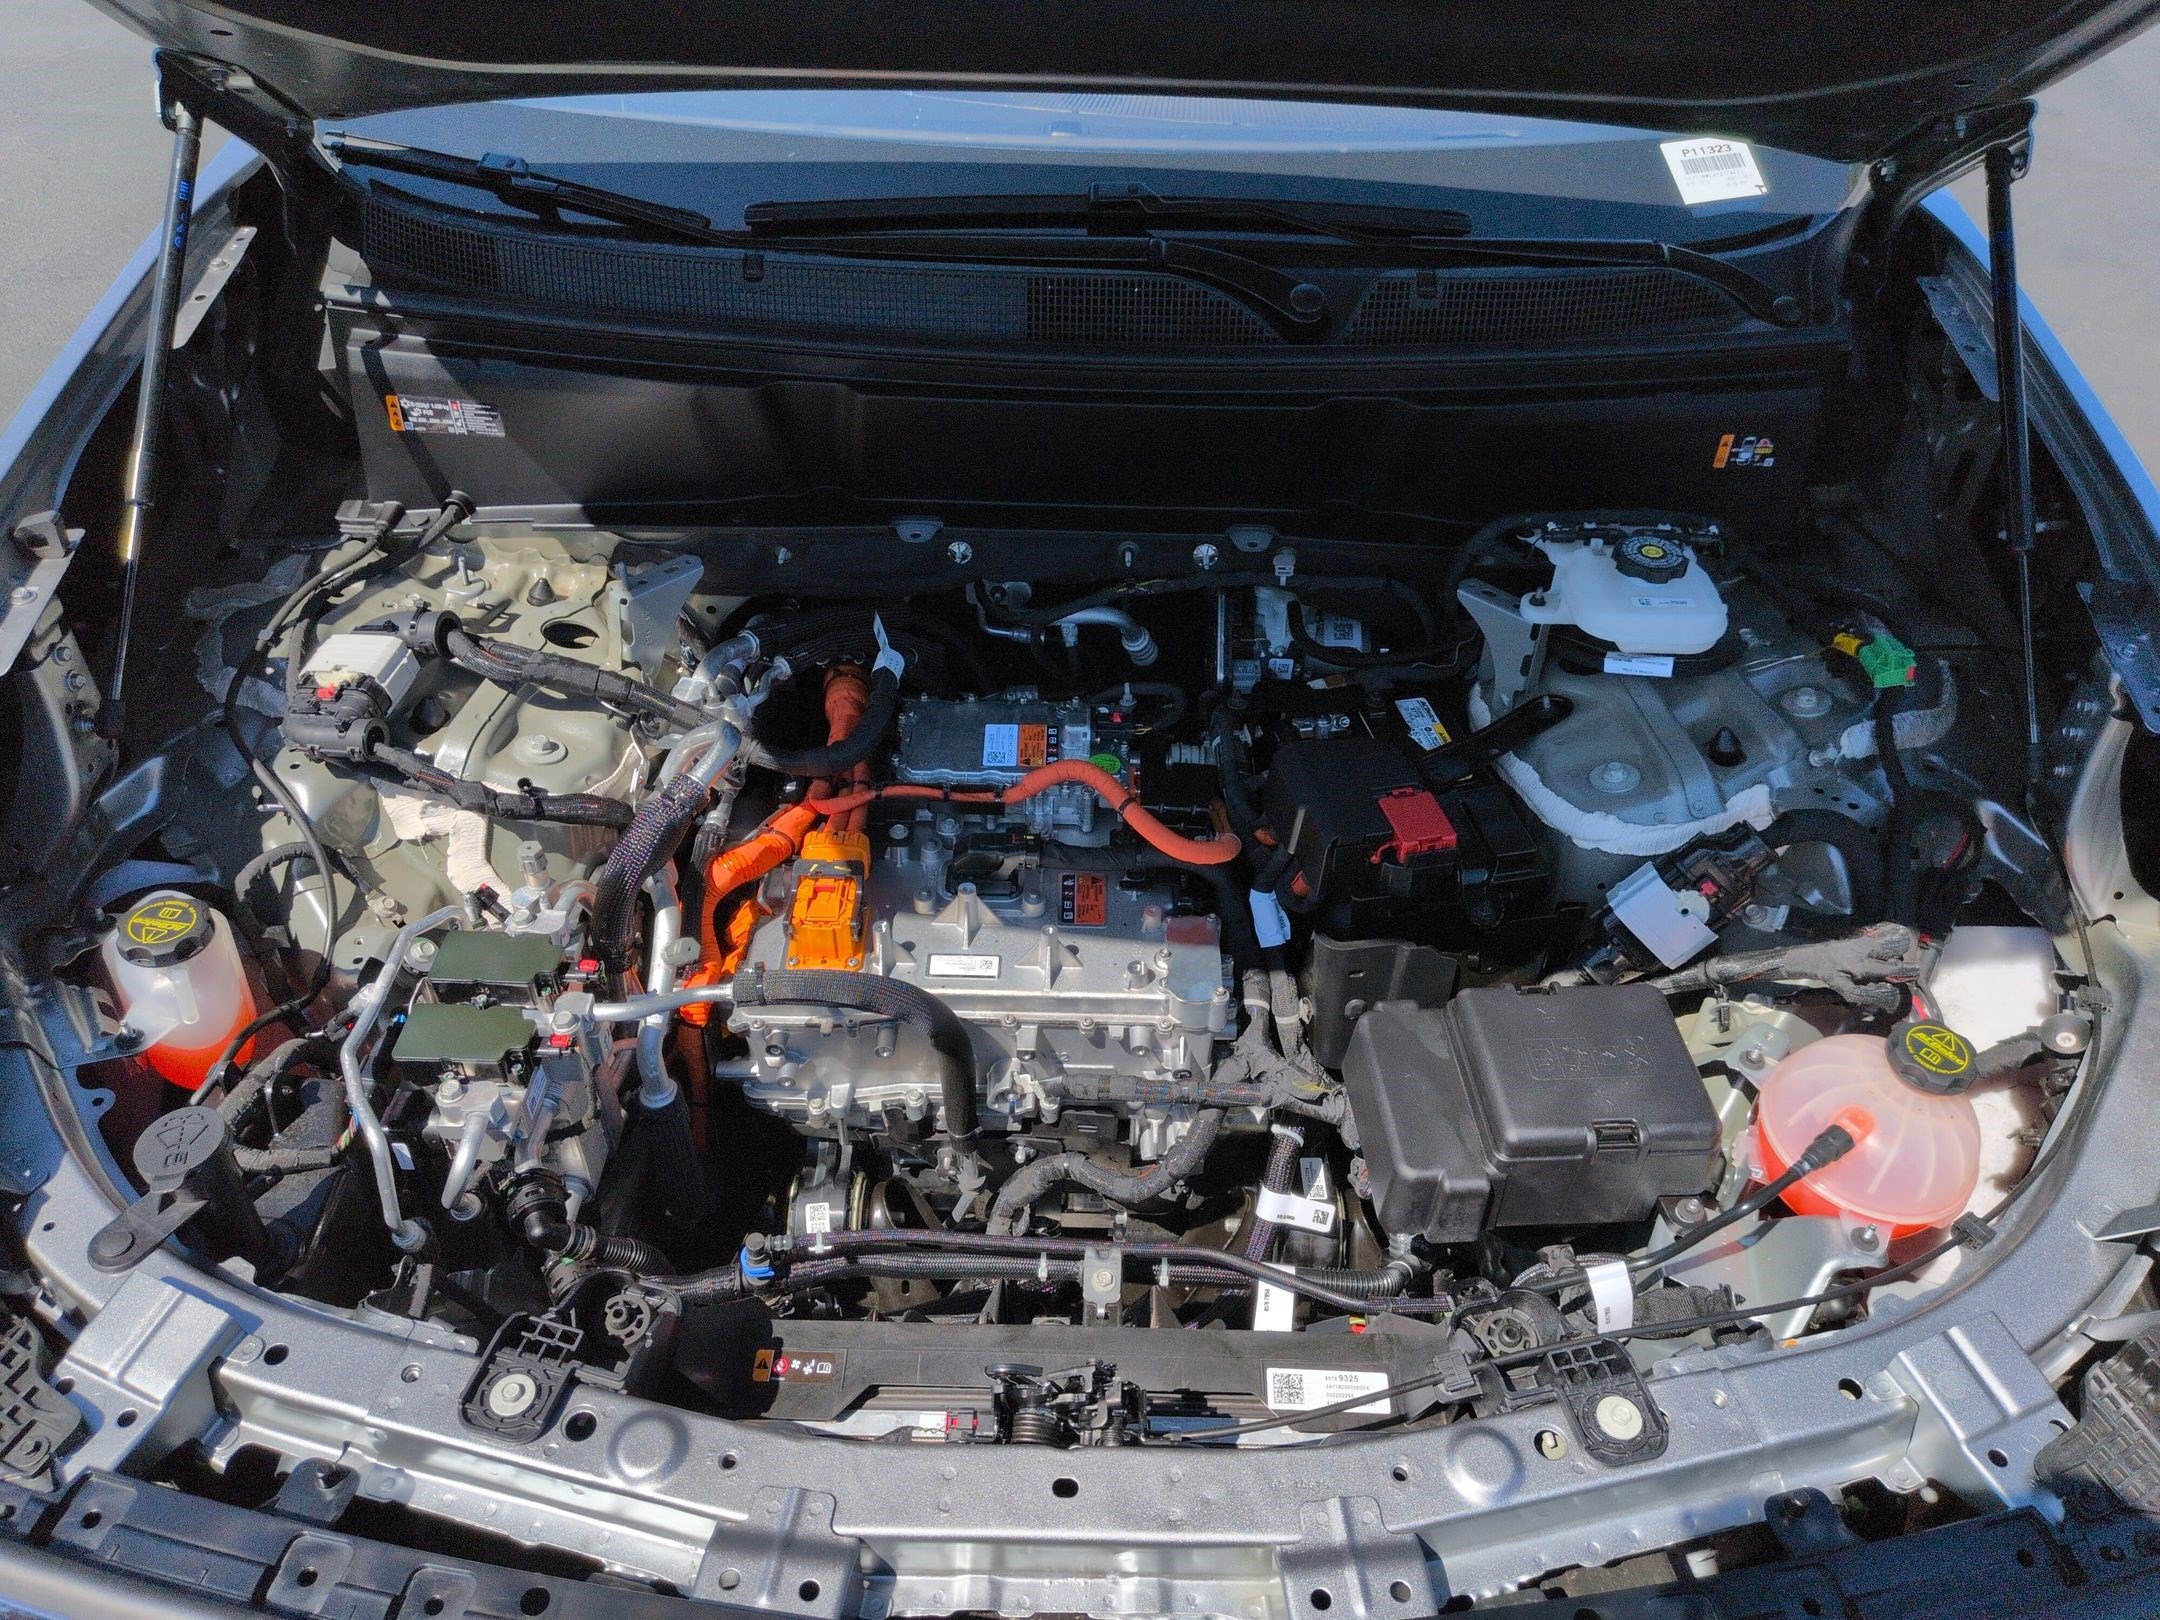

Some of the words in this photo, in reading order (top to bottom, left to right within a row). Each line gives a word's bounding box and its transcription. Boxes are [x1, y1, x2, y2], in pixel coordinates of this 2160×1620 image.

[1682, 144, 1732, 157] P11323
[132, 917, 188, 931] ACDelco
[1916, 1032, 1965, 1066] ACDelco
[1338, 1374, 1359, 1383] 9325
